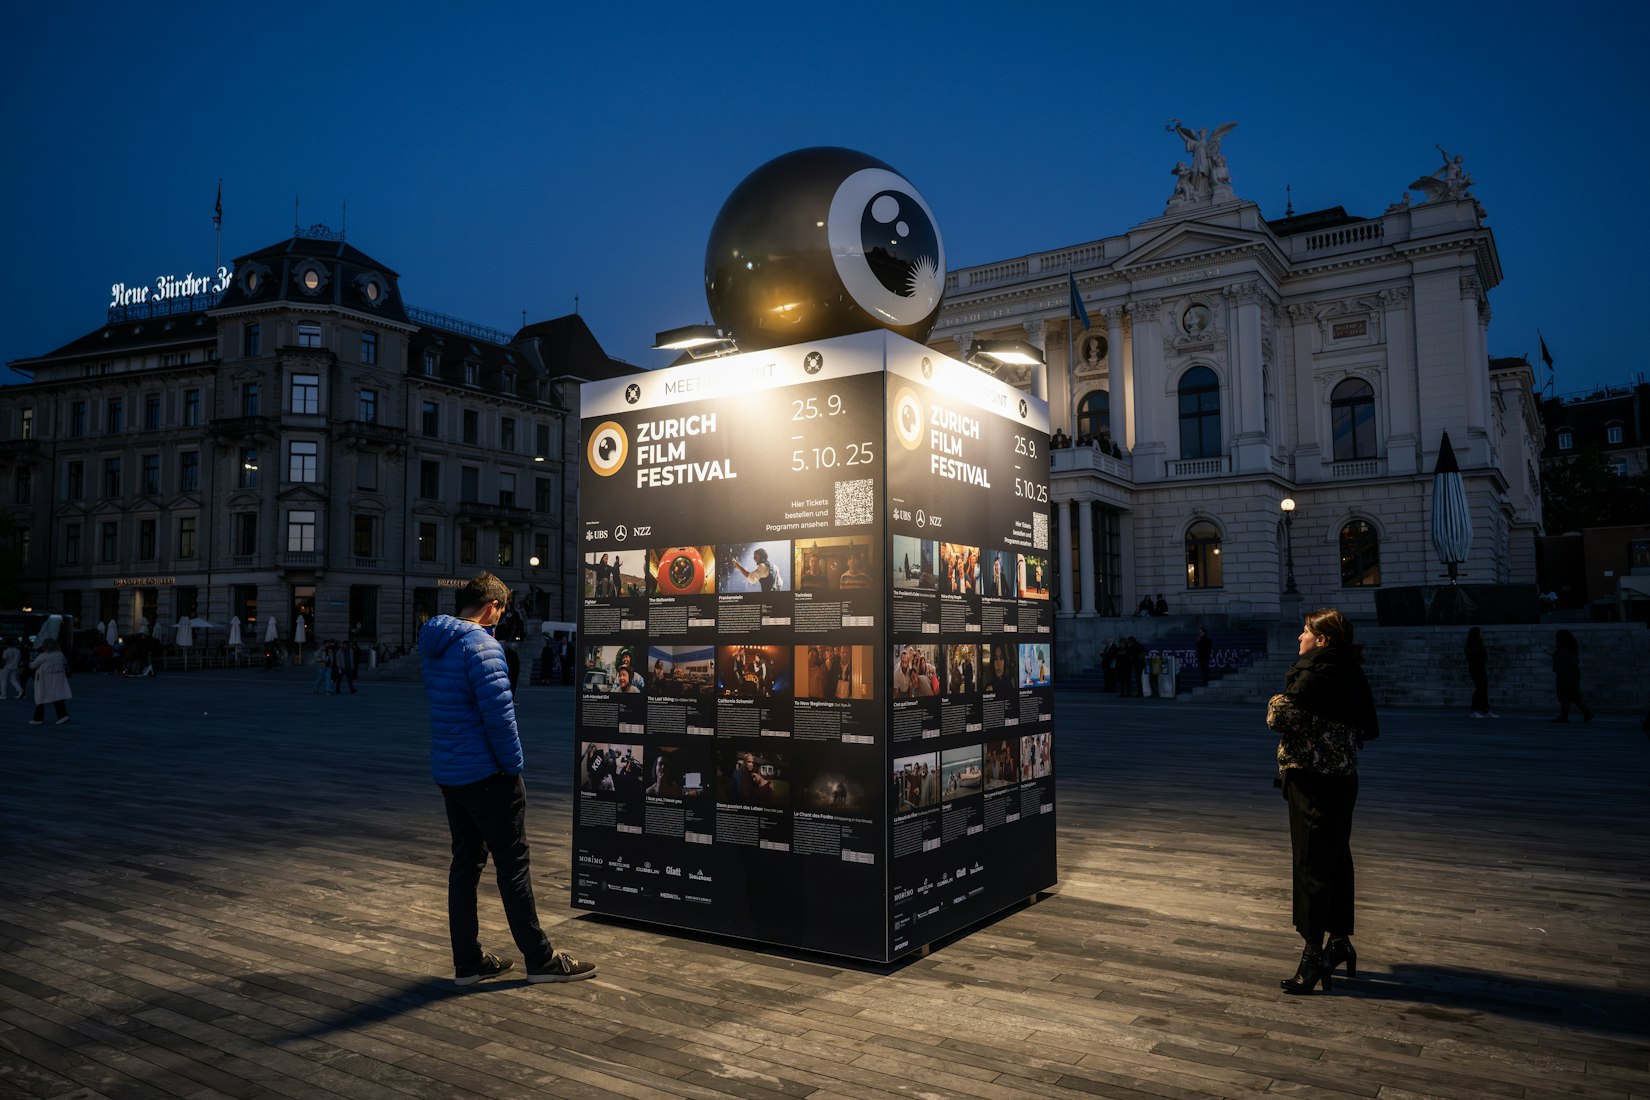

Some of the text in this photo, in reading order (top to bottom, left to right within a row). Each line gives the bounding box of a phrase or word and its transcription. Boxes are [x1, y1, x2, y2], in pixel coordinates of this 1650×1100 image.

[110, 283, 149, 308] Neue
[151, 272, 210, 302] Zürcher
[637, 413, 716, 443] ZURICH
[930, 405, 980, 440] ZURICH
[930, 430, 962, 457] FILM
[637, 441, 686, 466] FILM
[637, 459, 737, 488] FESTIVAL
[931, 454, 990, 488] FESTIVAL
[785, 511, 814, 519] bestellen
[900, 510, 911, 522] UBS
[929, 515, 942, 527] NZZ
[594, 530, 608, 539] UBS
[633, 527, 651, 536] NZZ
[766, 523, 800, 532] Programm
[666, 866, 681, 876] Glatt
